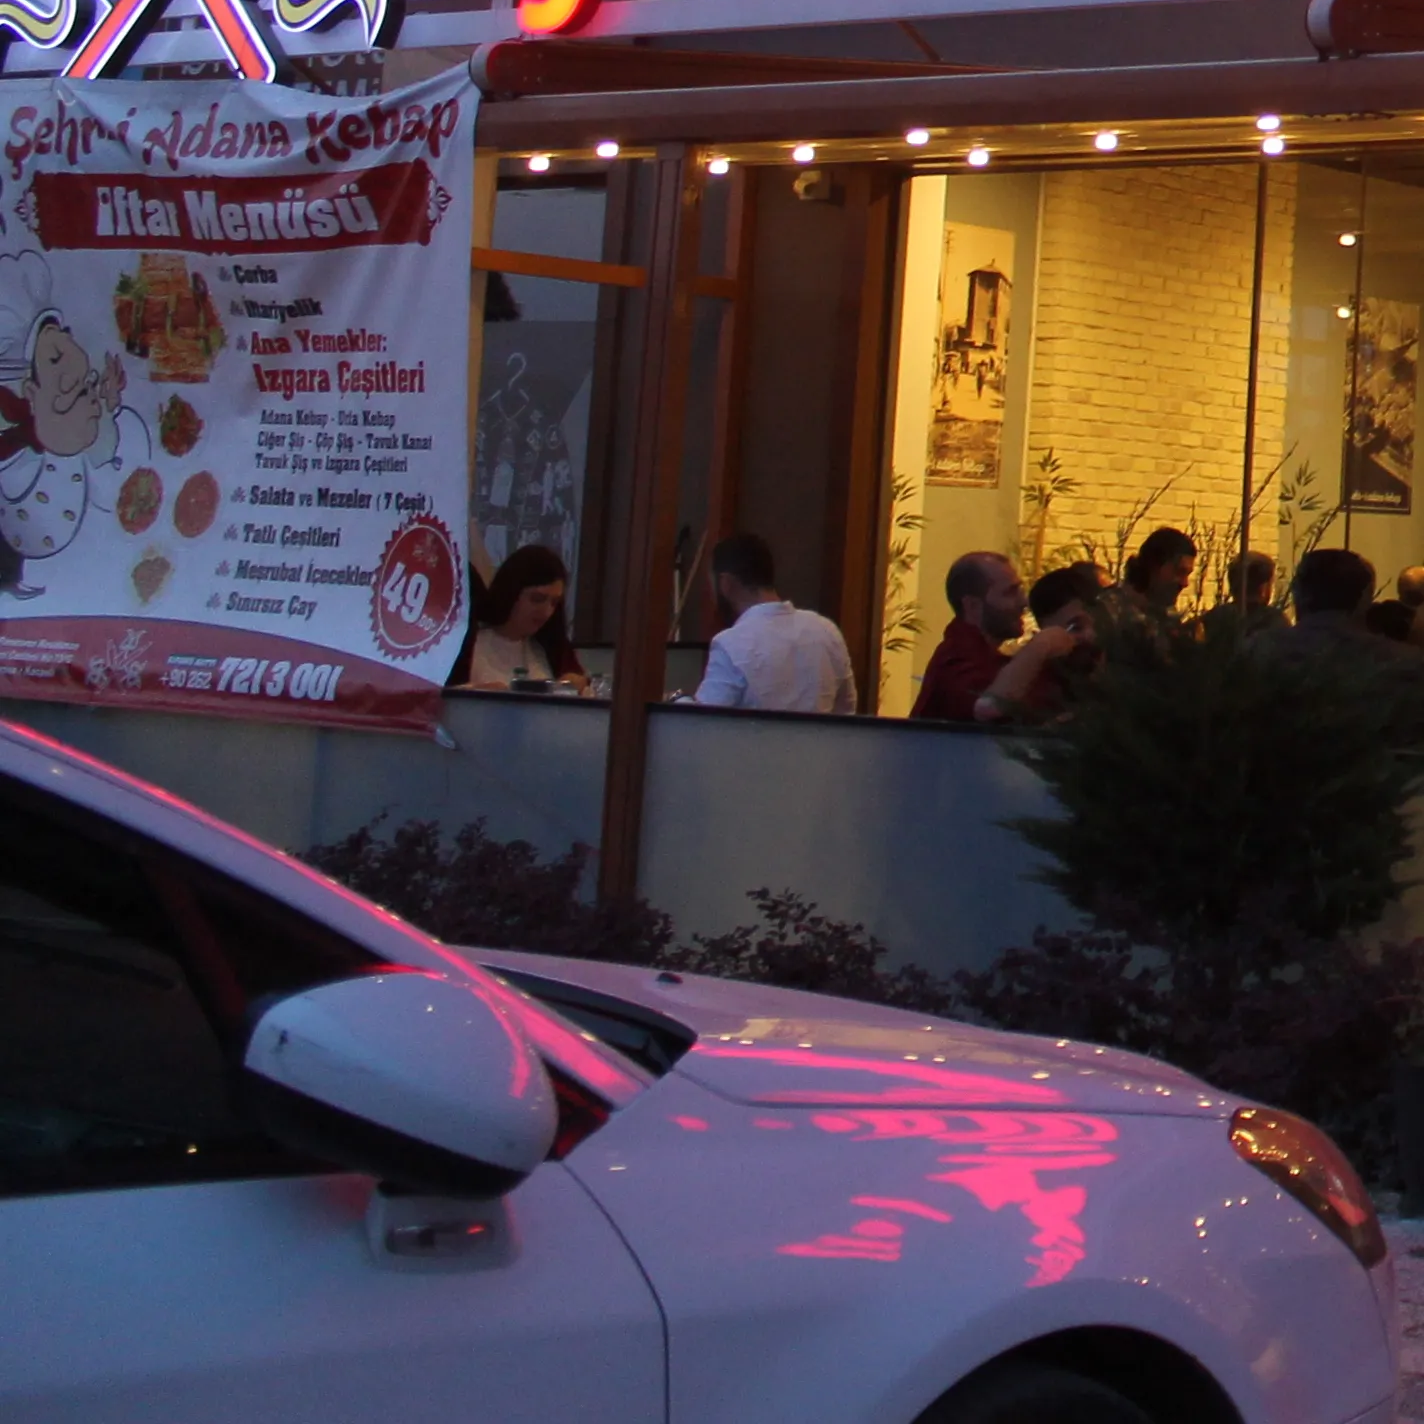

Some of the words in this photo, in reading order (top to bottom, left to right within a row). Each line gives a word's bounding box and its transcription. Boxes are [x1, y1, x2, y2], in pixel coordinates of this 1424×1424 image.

[142, 102, 292, 171] Adana
[305, 98, 459, 164] Kebap
[183, 183, 379, 242] Menüsü
[233, 264, 278, 286] Çorba
[251, 331, 291, 355] Ana
[294, 328, 387, 354] Yemekler:
[253, 363, 331, 401] Izgara
[337, 360, 425, 399] Çeşitleri
[259, 409, 293, 425] Adana
[296, 410, 328, 429] Kebap
[363, 410, 396, 430] Kebap
[257, 431, 286, 451] Ciğer
[365, 433, 399, 450] Tavuk
[402, 433, 432, 451] Kanat
[255, 453, 288, 469] Tavuk
[311, 458, 323, 471] ve
[363, 456, 408, 478] Çeşitleri
[250, 485, 295, 507] Salata
[298, 493, 313, 507] ve
[317, 487, 372, 510] Mezeler
[243, 524, 276, 545] Tatlı
[281, 525, 341, 551] Çeşitleri
[225, 591, 284, 614] Sınırsız
[287, 595, 318, 621] Çay
[382, 561, 429, 624] 49
[216, 656, 270, 694] 721
[266, 660, 291, 697] 3
[289, 662, 344, 701] 001
